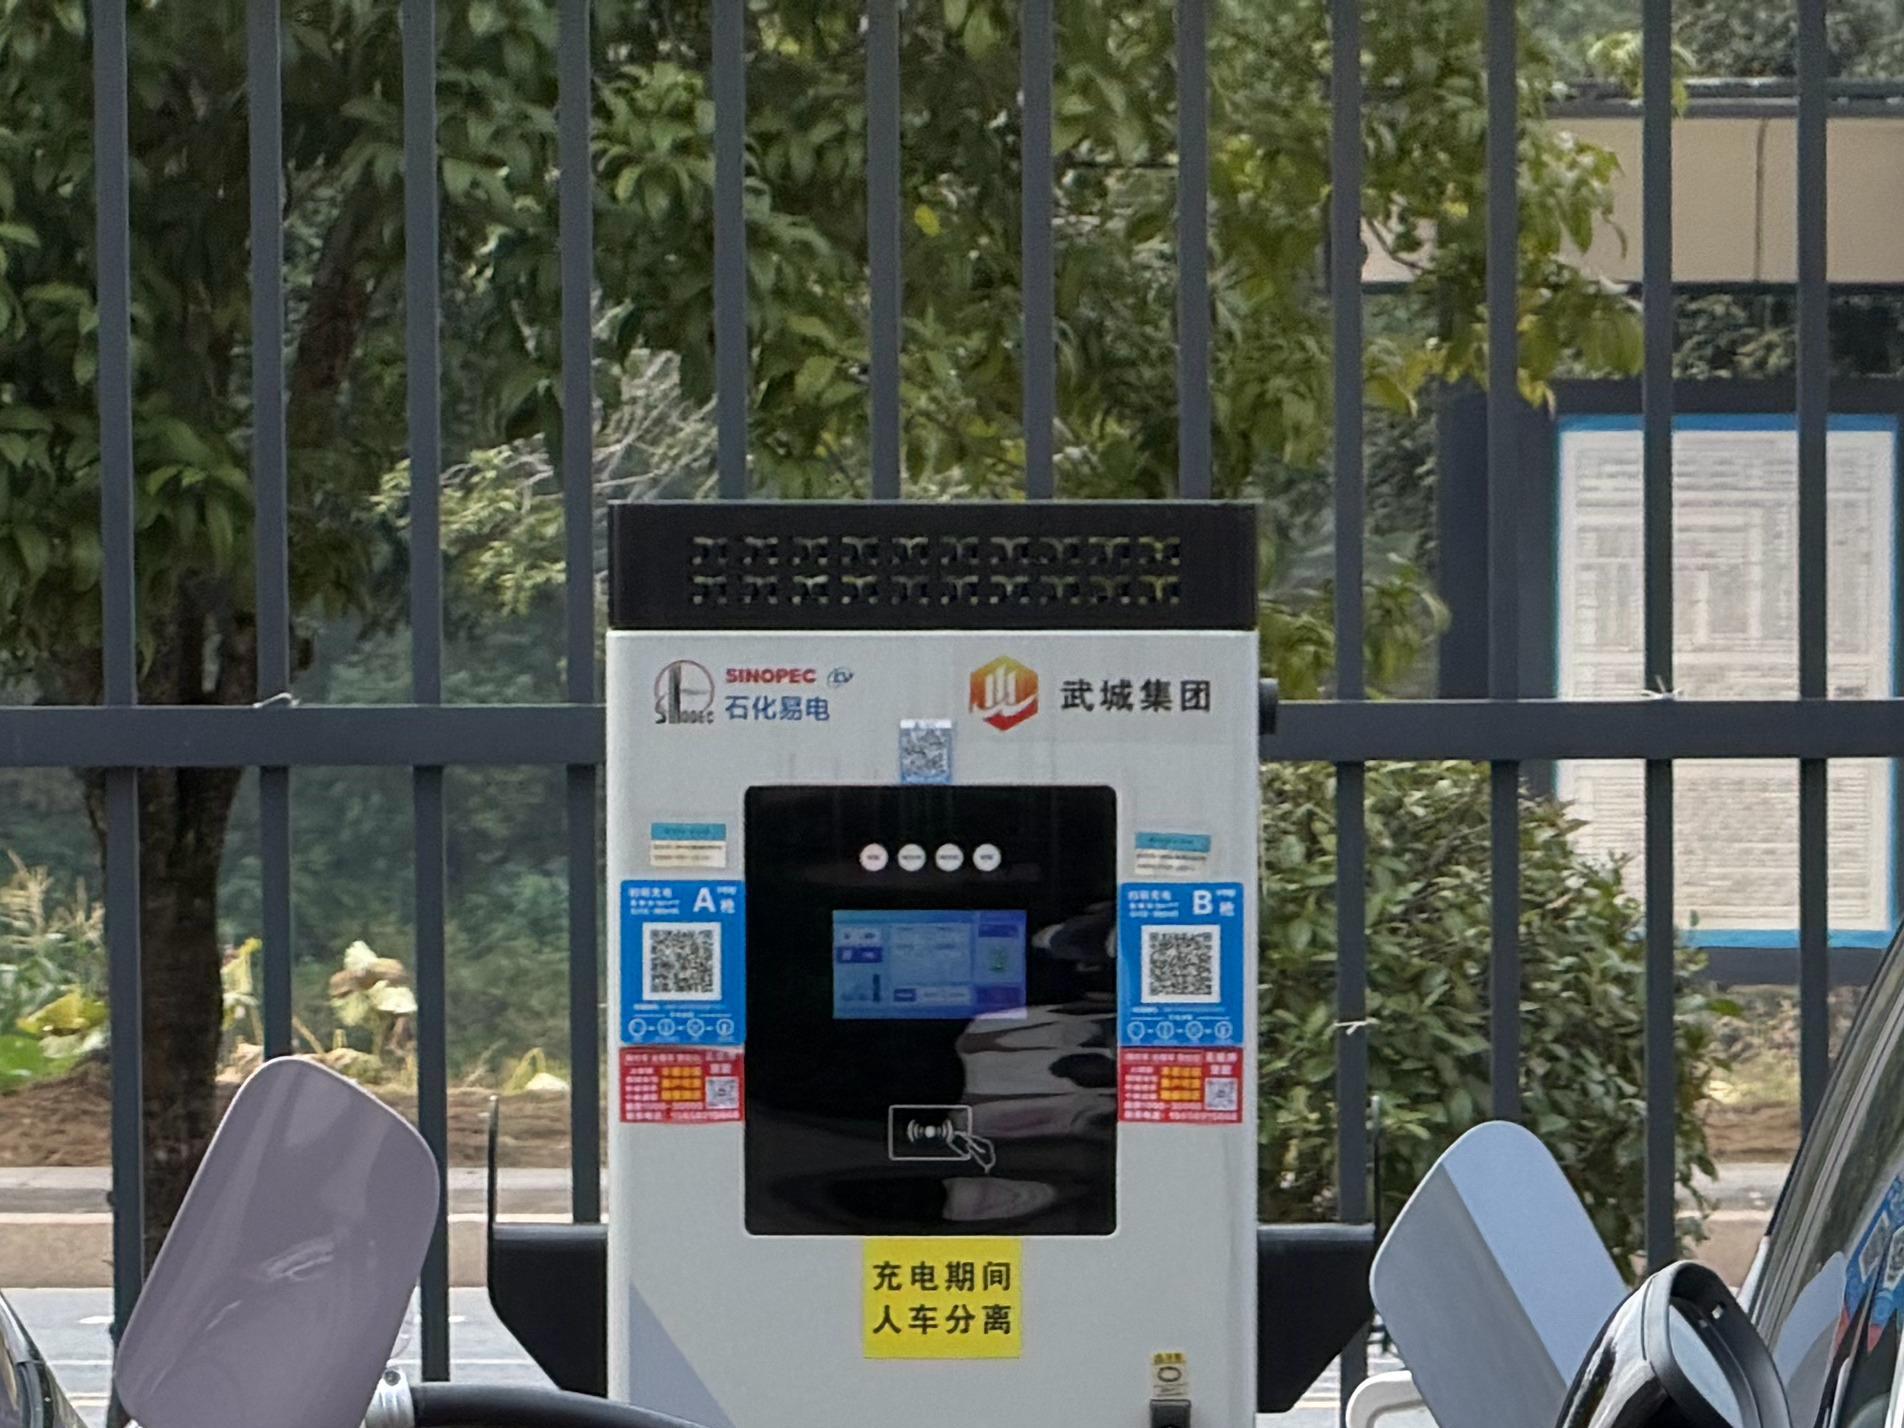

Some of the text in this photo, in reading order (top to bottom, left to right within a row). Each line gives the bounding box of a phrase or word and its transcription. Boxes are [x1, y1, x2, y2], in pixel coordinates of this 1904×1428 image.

[725, 667, 817, 684] SINOPEC
[724, 695, 831, 722] 石化易电
[1059, 678, 1213, 713] 武城集团
[693, 886, 717, 913] A
[1192, 889, 1214, 915] B
[872, 1260, 1013, 1292] 充电期间
[872, 1303, 1013, 1336] 人车分离
